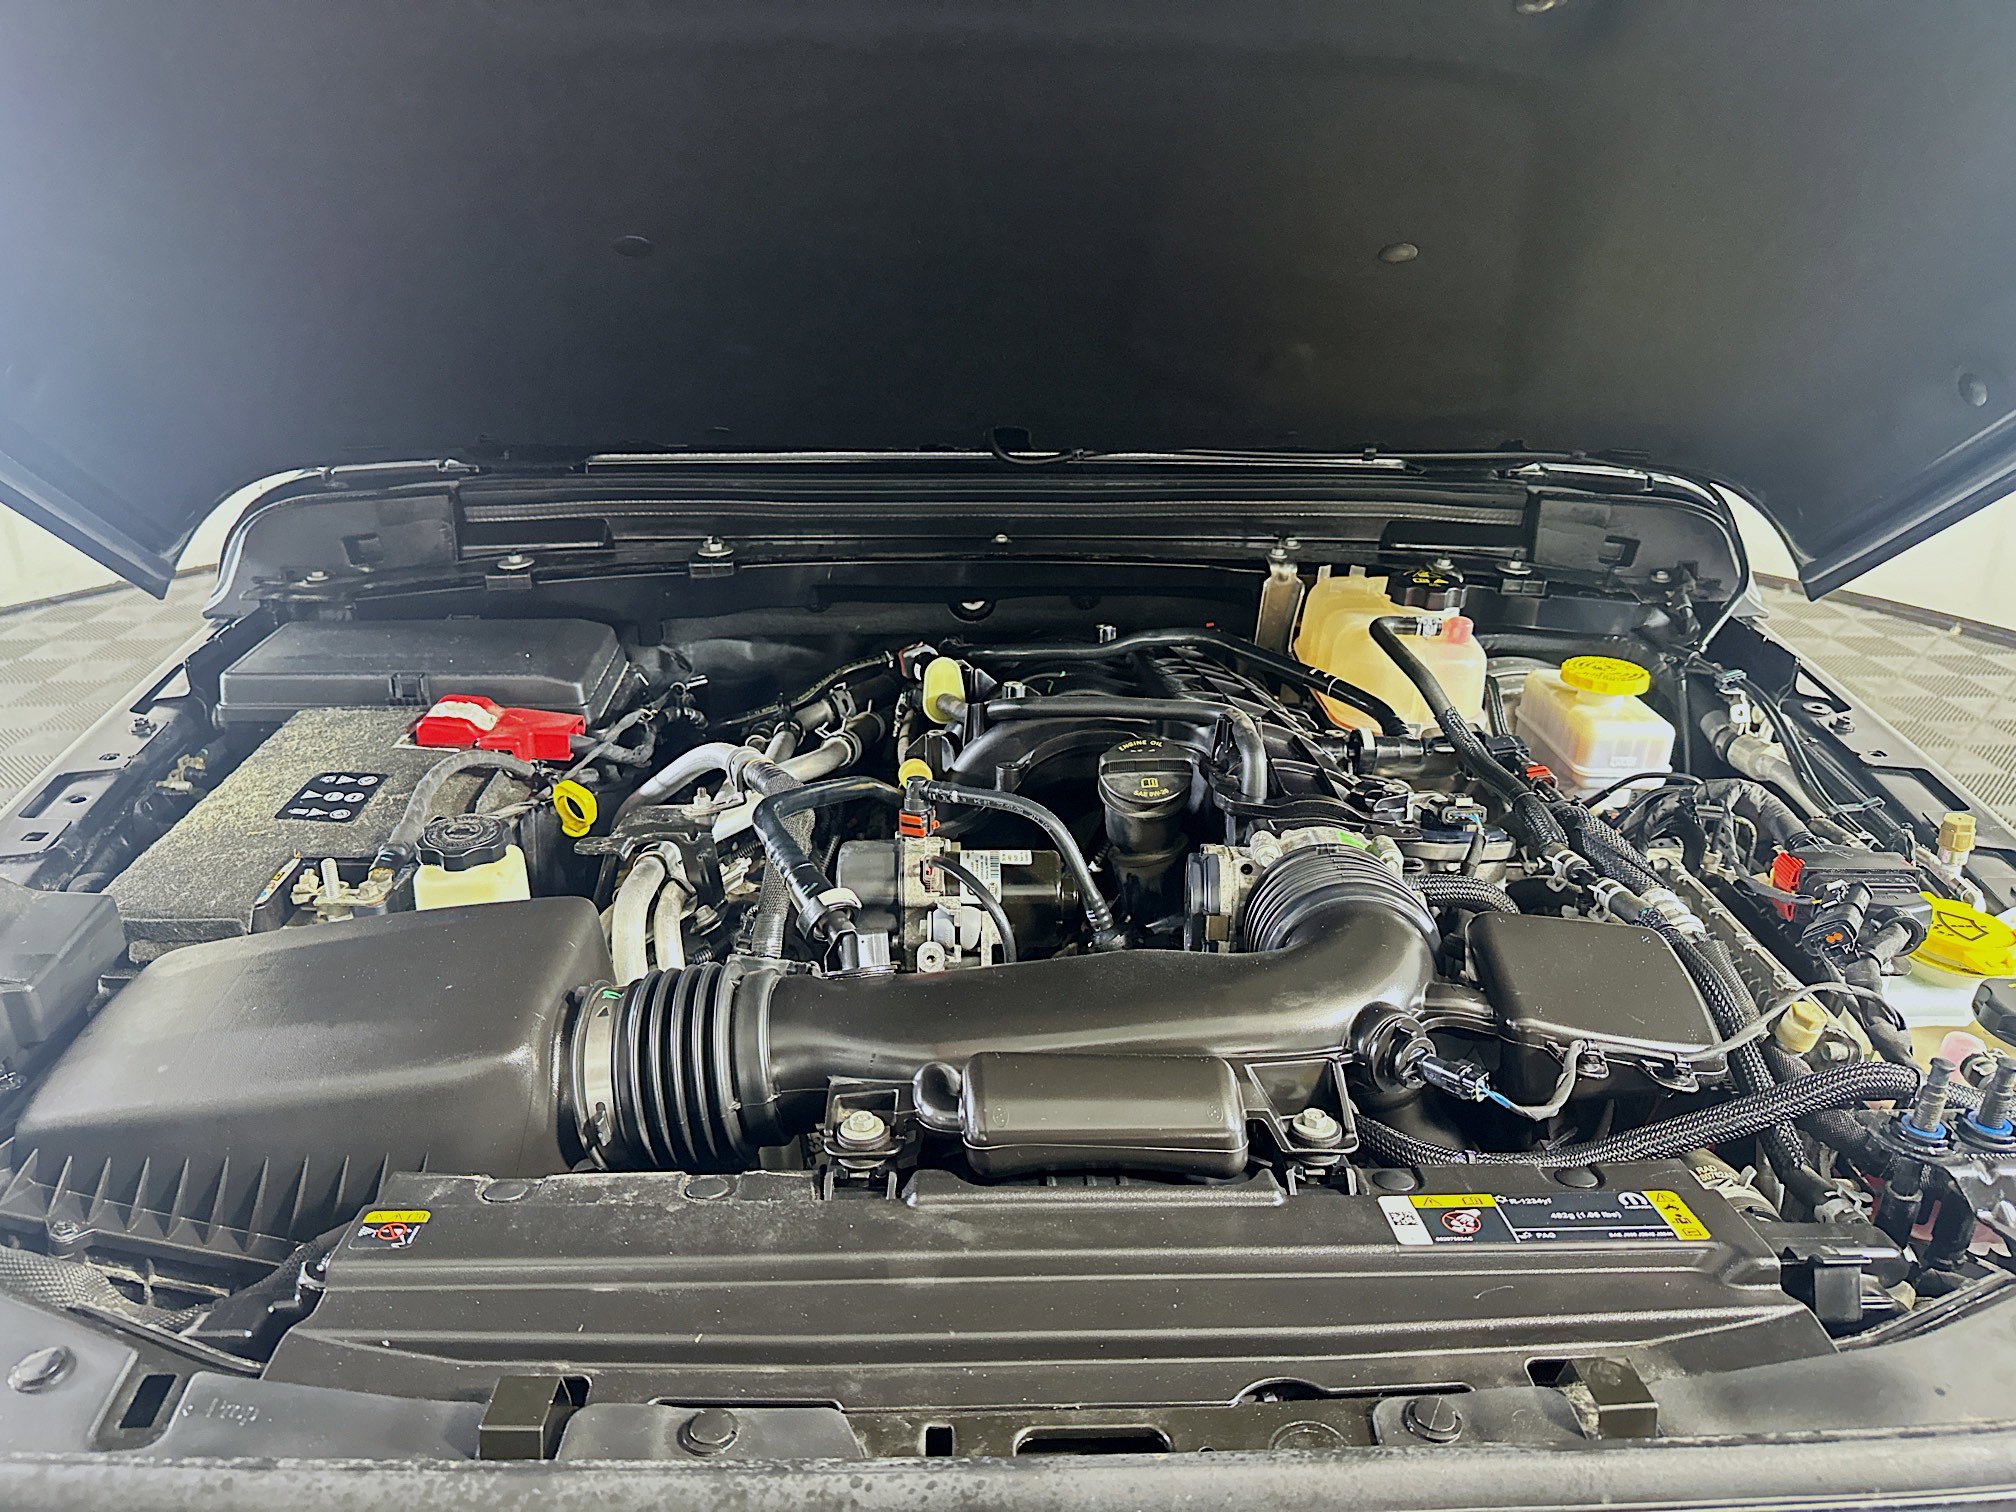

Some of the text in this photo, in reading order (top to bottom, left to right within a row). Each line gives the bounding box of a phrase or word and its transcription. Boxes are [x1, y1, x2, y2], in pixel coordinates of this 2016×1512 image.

[1118, 740, 1163, 752] ENGINE OIL
[1133, 789, 1148, 797] SAE
[1695, 1164, 1718, 1175] RAD
